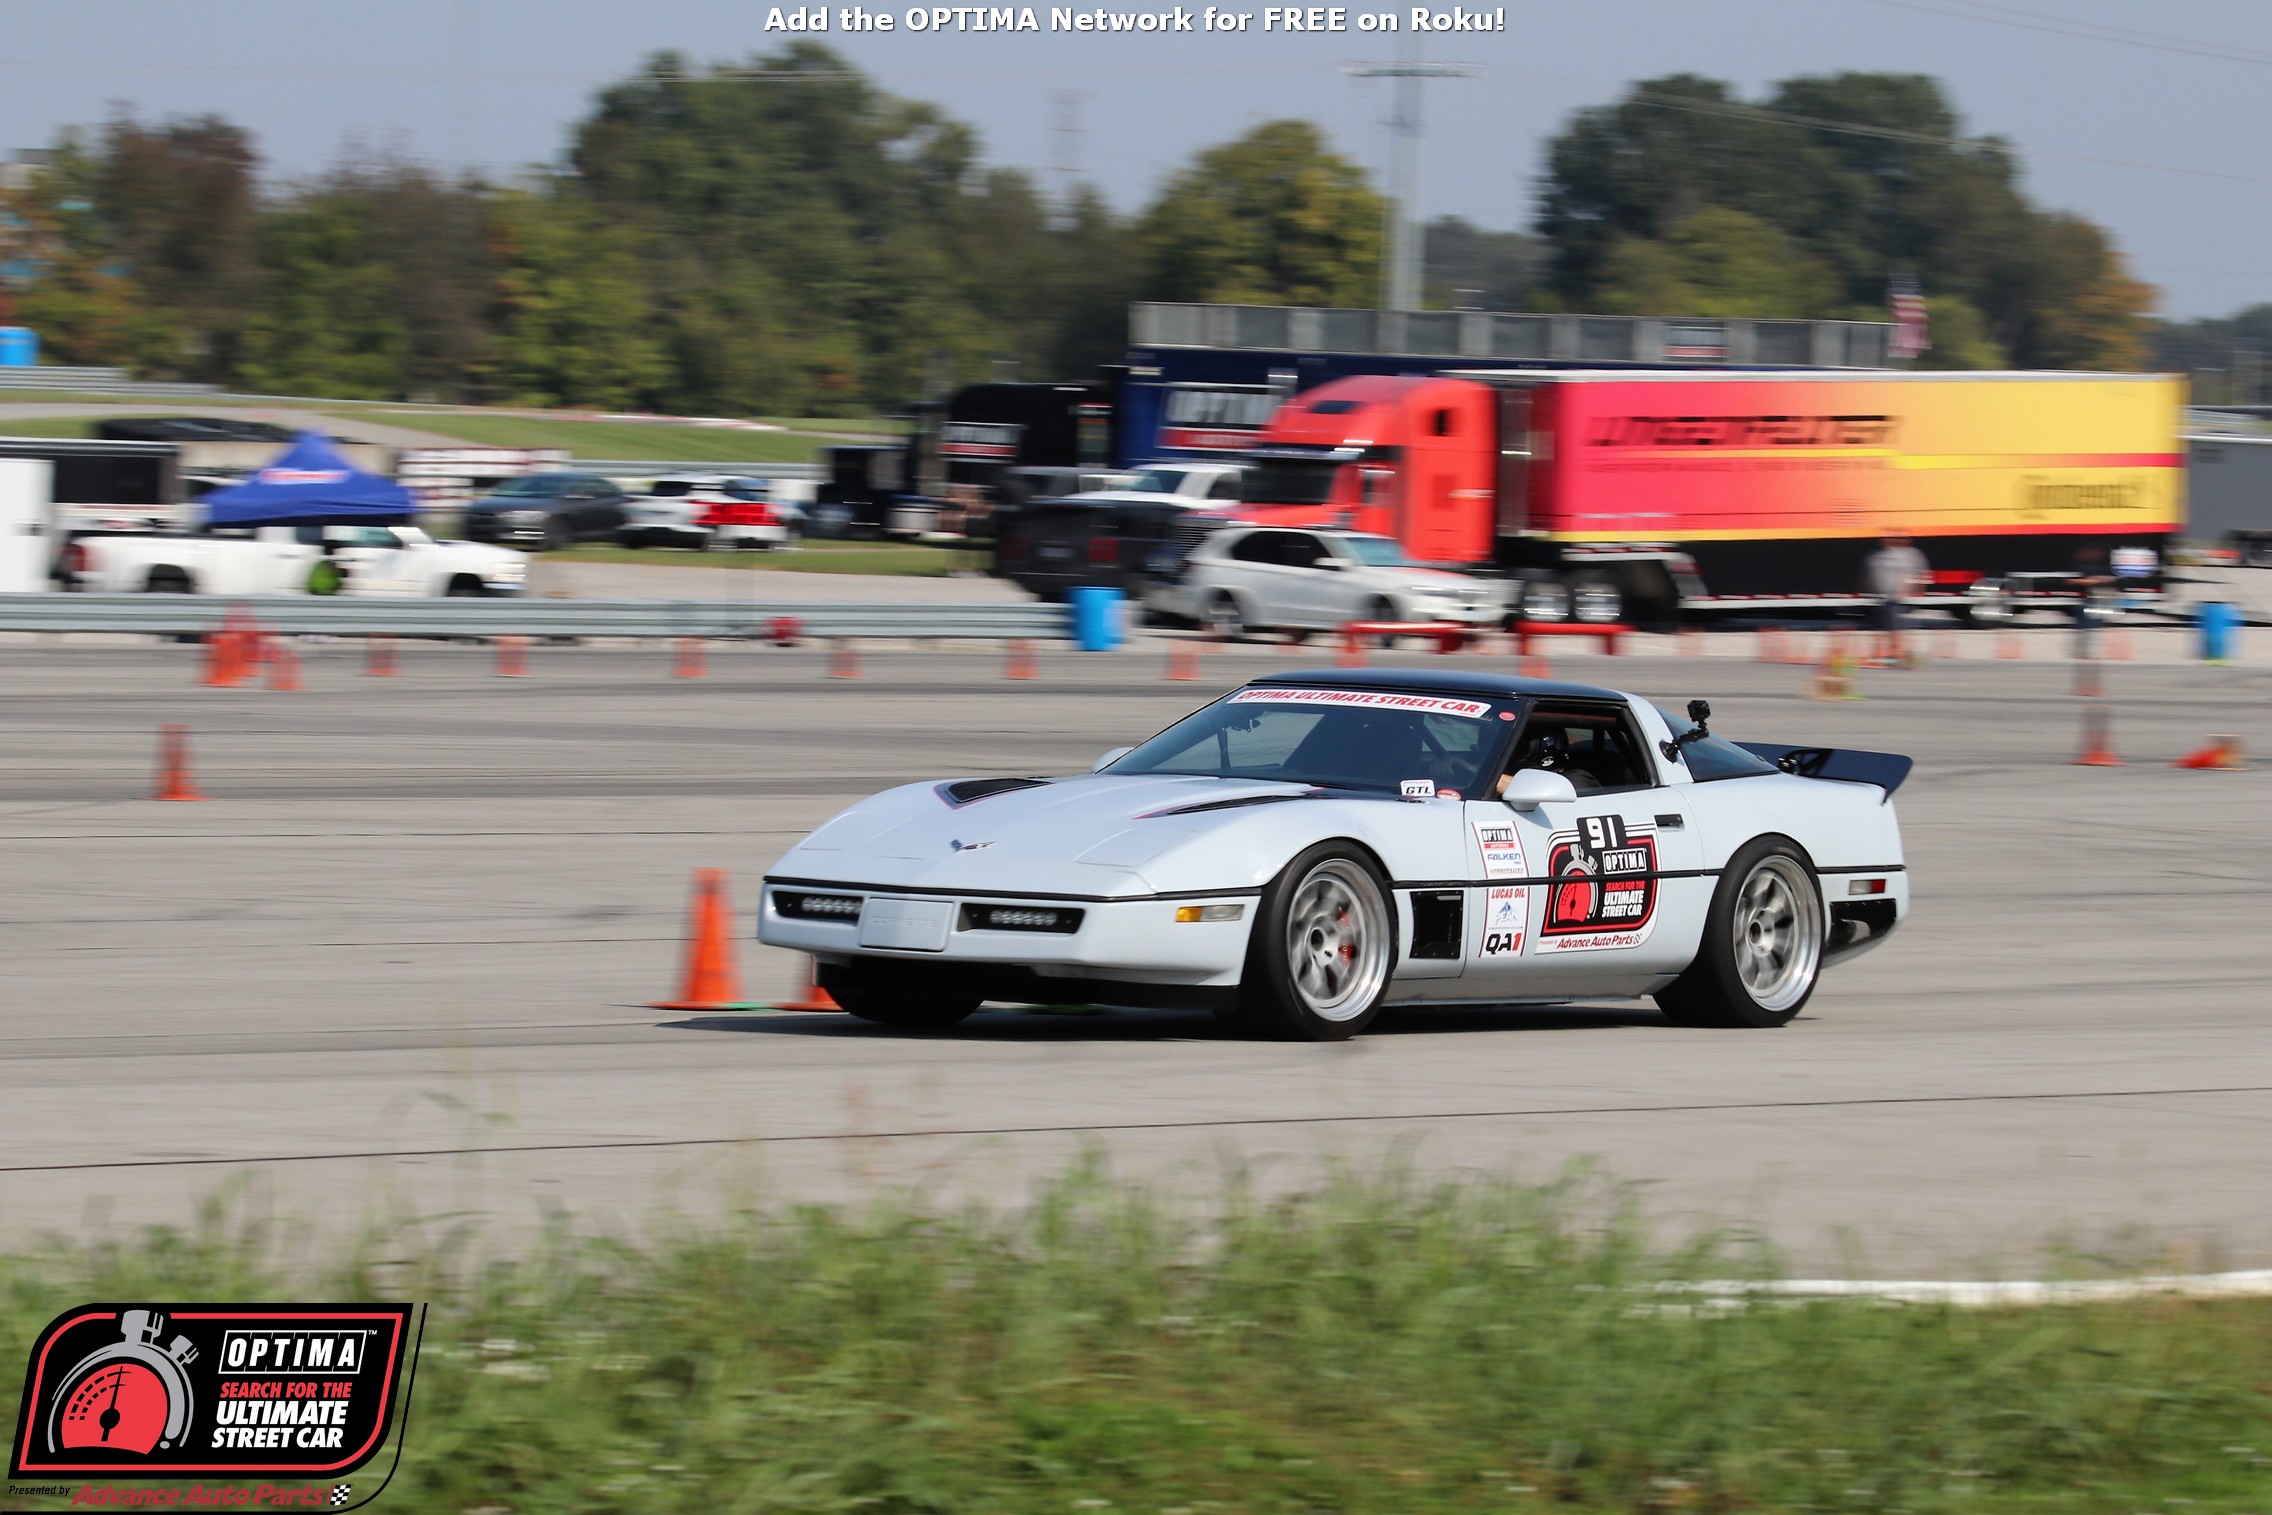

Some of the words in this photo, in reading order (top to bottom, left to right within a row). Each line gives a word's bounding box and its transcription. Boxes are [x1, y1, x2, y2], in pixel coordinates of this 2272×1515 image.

[1238, 691, 1296, 700] OPTIMA
[1295, 692, 1377, 703] ULTIMATE
[1376, 695, 1442, 708] STREET
[1441, 701, 1481, 713] CAR
[1405, 786, 1432, 794] GTL
[1482, 829, 1513, 842] OPTIMA
[1586, 817, 1618, 849] 91
[1487, 852, 1521, 861] FALKEN
[1604, 851, 1645, 871] OPTIMA
[1491, 888, 1514, 899] LUCAS
[1514, 887, 1525, 898] OIL
[1605, 881, 1625, 891] SEARCH
[1625, 881, 1635, 890] FOR
[1636, 880, 1646, 890] THE
[1603, 890, 1645, 906] ULTIMATE
[1601, 904, 1628, 918] STREET
[1627, 903, 1643, 916] CAR
[1485, 933, 1523, 955] QA1
[1557, 938, 1591, 949] Advance
[1590, 936, 1612, 947] Auto
[1611, 934, 1634, 946] Parts
